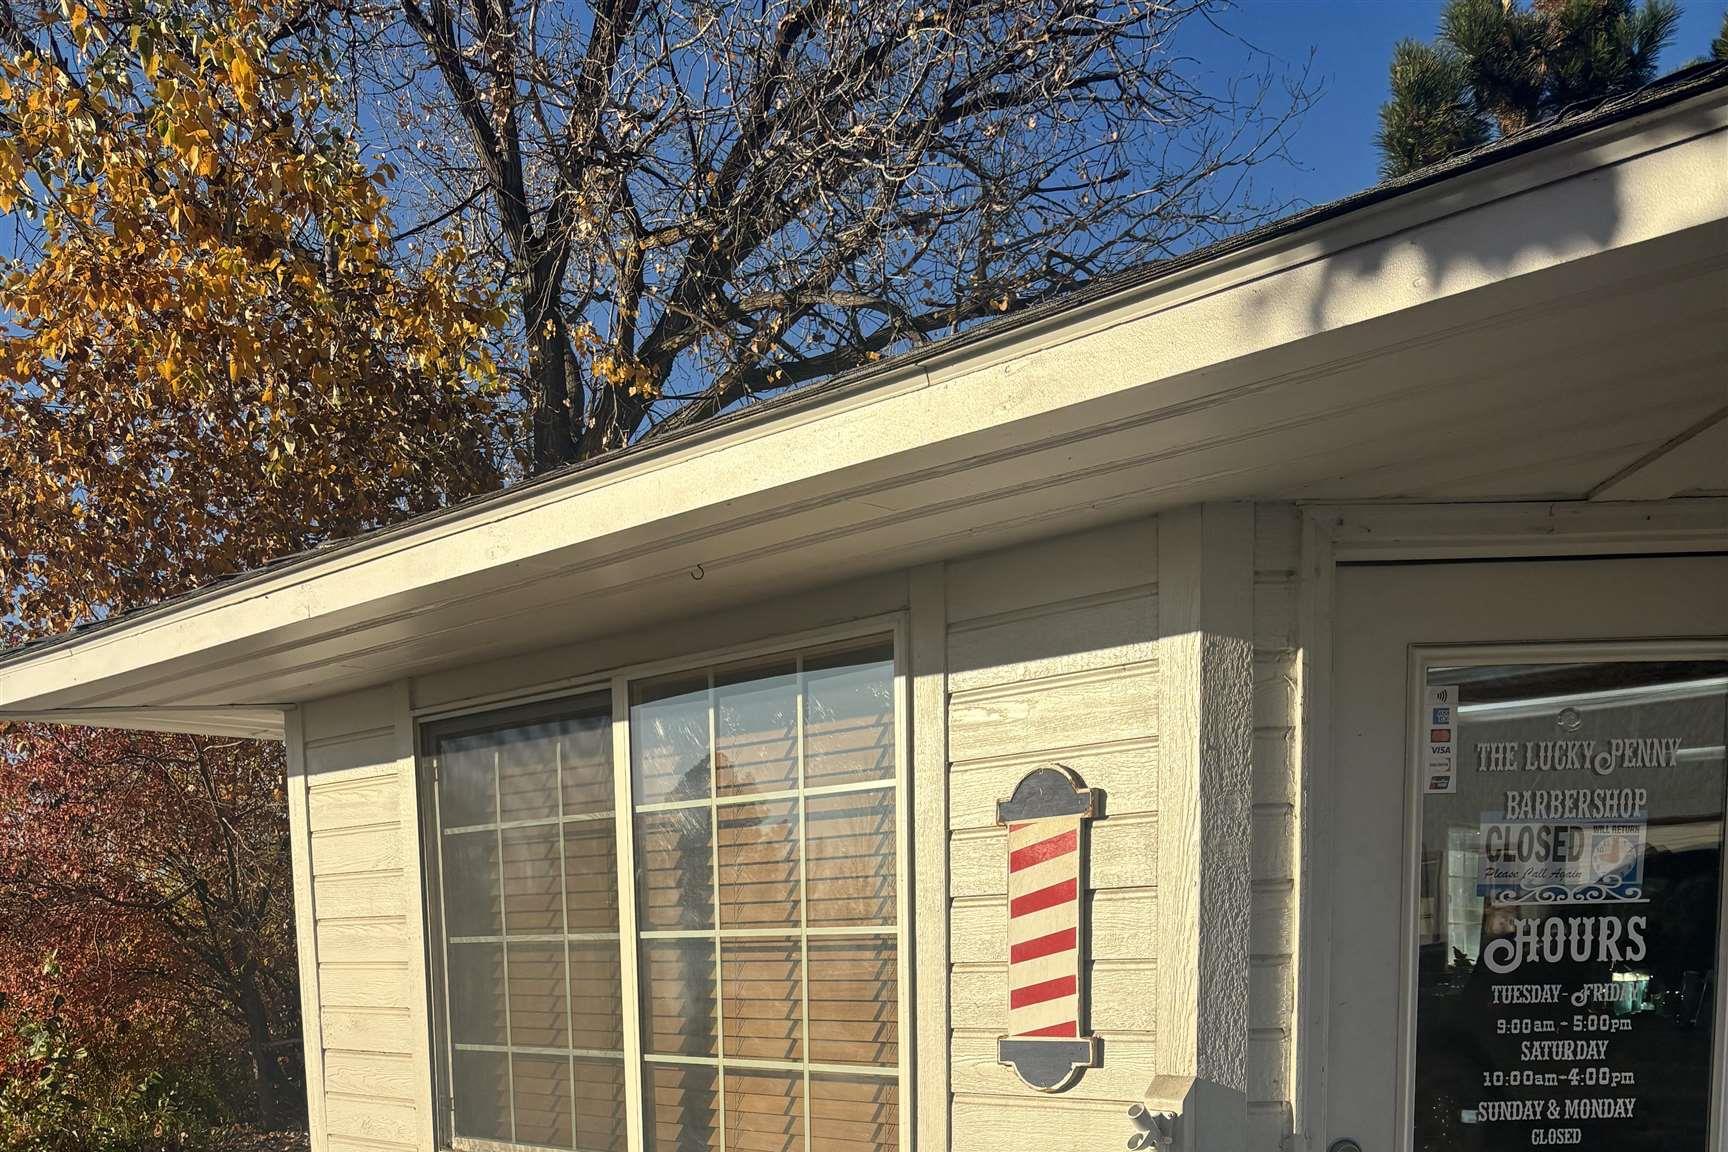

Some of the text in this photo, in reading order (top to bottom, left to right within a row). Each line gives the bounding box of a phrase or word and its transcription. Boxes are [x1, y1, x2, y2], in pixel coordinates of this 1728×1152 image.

[1432, 746, 1451, 754] VISA
[1476, 736, 1682, 775] THE LUCKY PENNY
[1505, 788, 1647, 820] BARBERSHOP
[1593, 824, 1640, 834] WILL RETURN
[1485, 824, 1585, 864] CLOSED
[1484, 865, 1582, 880] Please Call Again
[1483, 916, 1648, 974] HOURS
[1570, 983, 1640, 1007] FRIDAY
[1521, 1040, 1609, 1061] SATURDAY
[1478, 1098, 1637, 1122] SUNDAY & MONDAY
[1531, 1128, 1582, 1145] CLOSED
